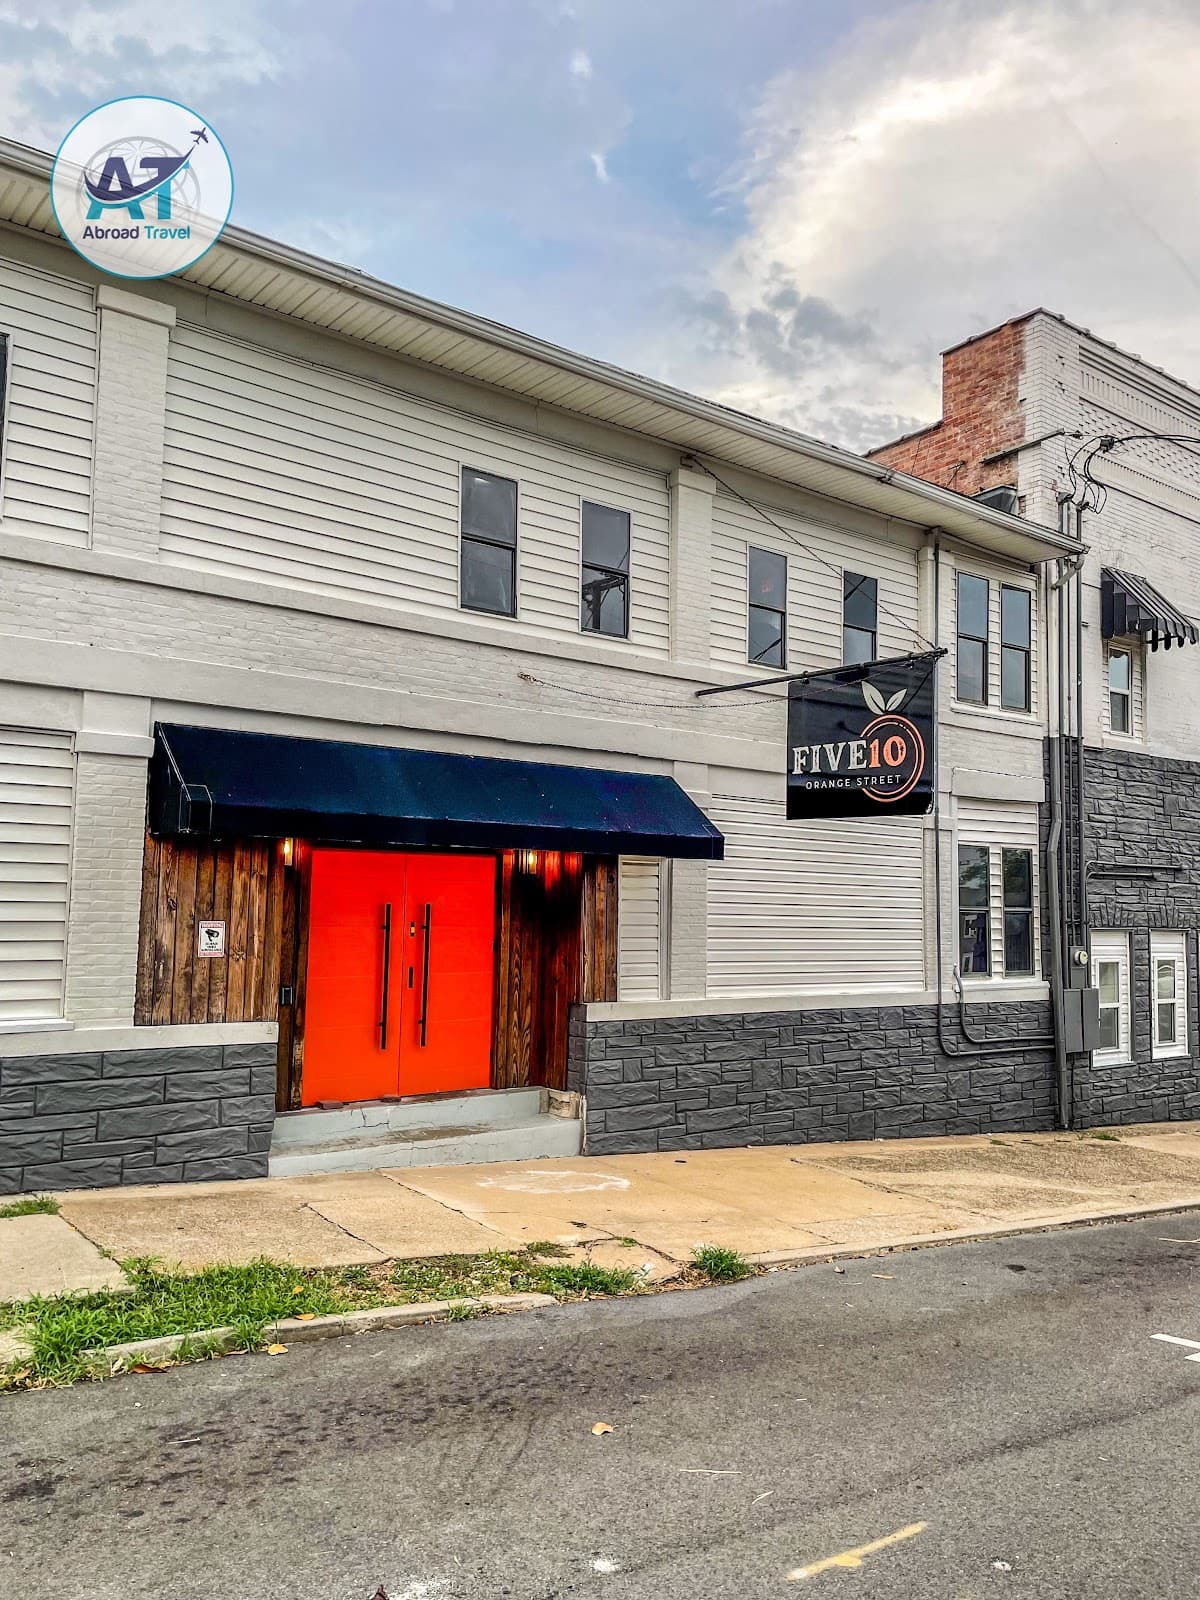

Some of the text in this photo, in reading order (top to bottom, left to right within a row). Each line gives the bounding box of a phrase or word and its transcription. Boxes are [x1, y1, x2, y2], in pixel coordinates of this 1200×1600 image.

[792, 736, 906, 774] FIVE10
[805, 774, 902, 790] ORANGE STREET
